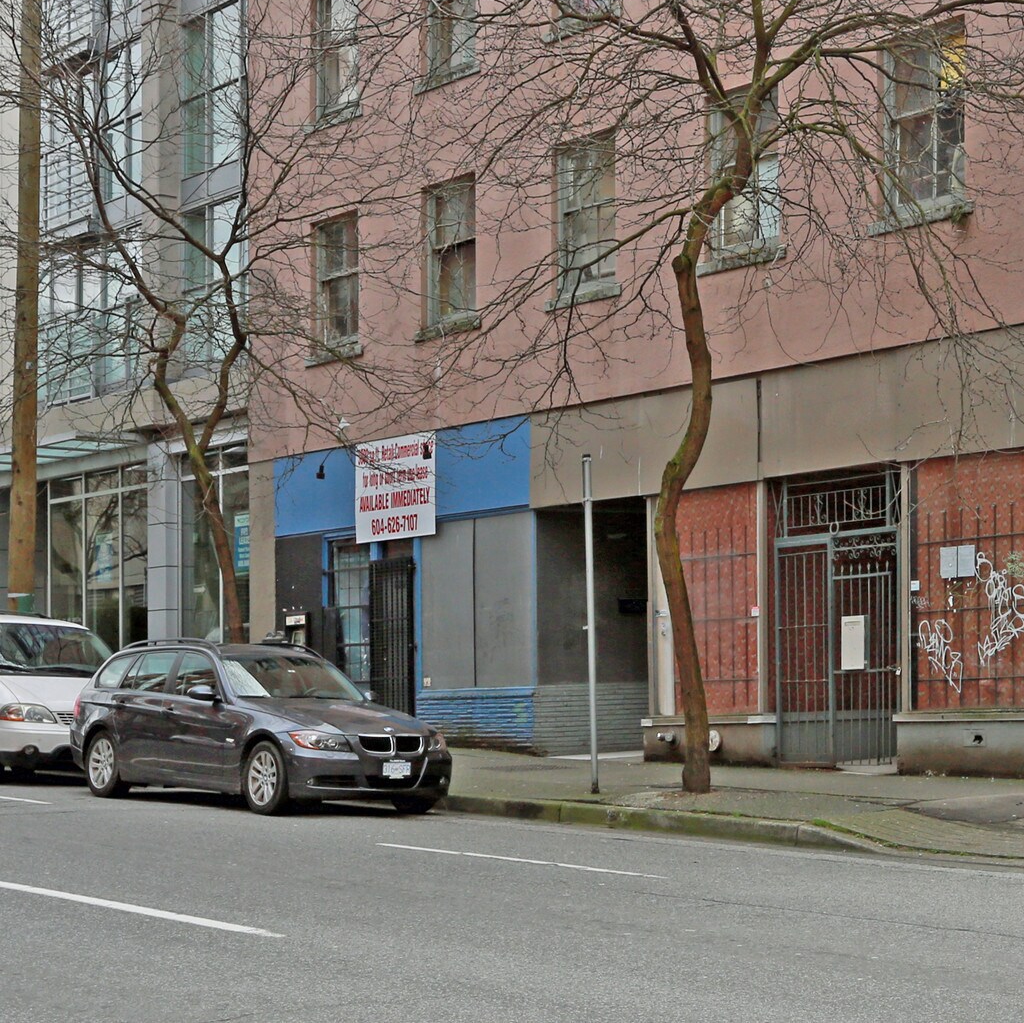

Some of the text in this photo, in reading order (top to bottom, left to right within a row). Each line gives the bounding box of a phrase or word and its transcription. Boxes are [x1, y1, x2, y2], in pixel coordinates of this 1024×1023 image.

[360, 486, 430, 513] AVAILABLE IMMEDIATELY
[371, 514, 418, 536] 604-626-7107
